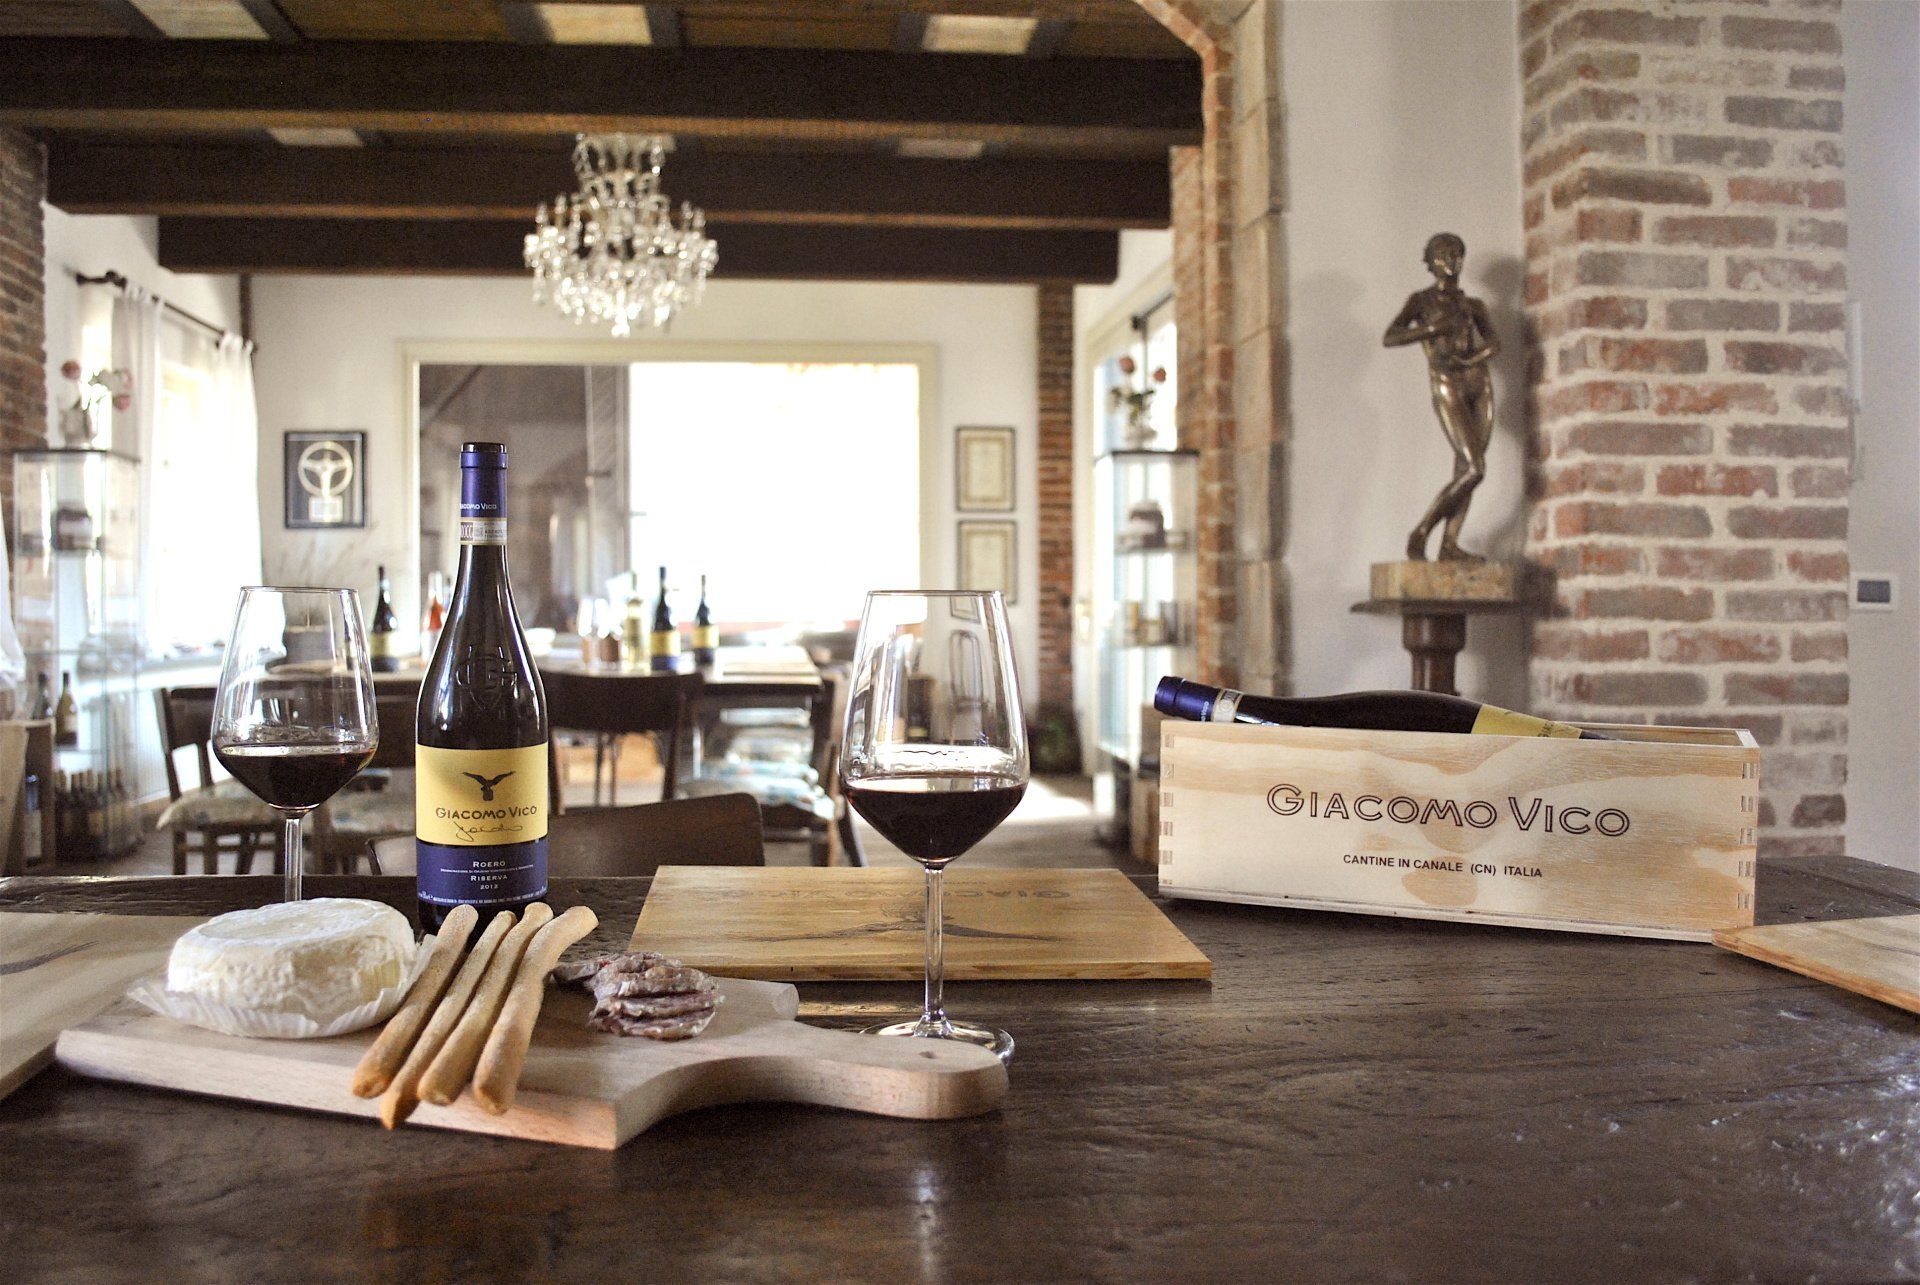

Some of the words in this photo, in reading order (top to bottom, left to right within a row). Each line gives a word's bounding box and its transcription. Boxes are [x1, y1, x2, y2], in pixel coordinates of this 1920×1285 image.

[435, 807, 506, 820] GIACOMO
[508, 805, 537, 818] VICO
[1266, 783, 1497, 829] GIACOMO
[1508, 796, 1630, 837] VICO
[1343, 854, 1395, 867] CANTINE
[1398, 858, 1410, 868] IN
[1413, 859, 1463, 872] CANALE
[1470, 863, 1496, 876] (CN)
[1504, 865, 1542, 877] ITALIA
